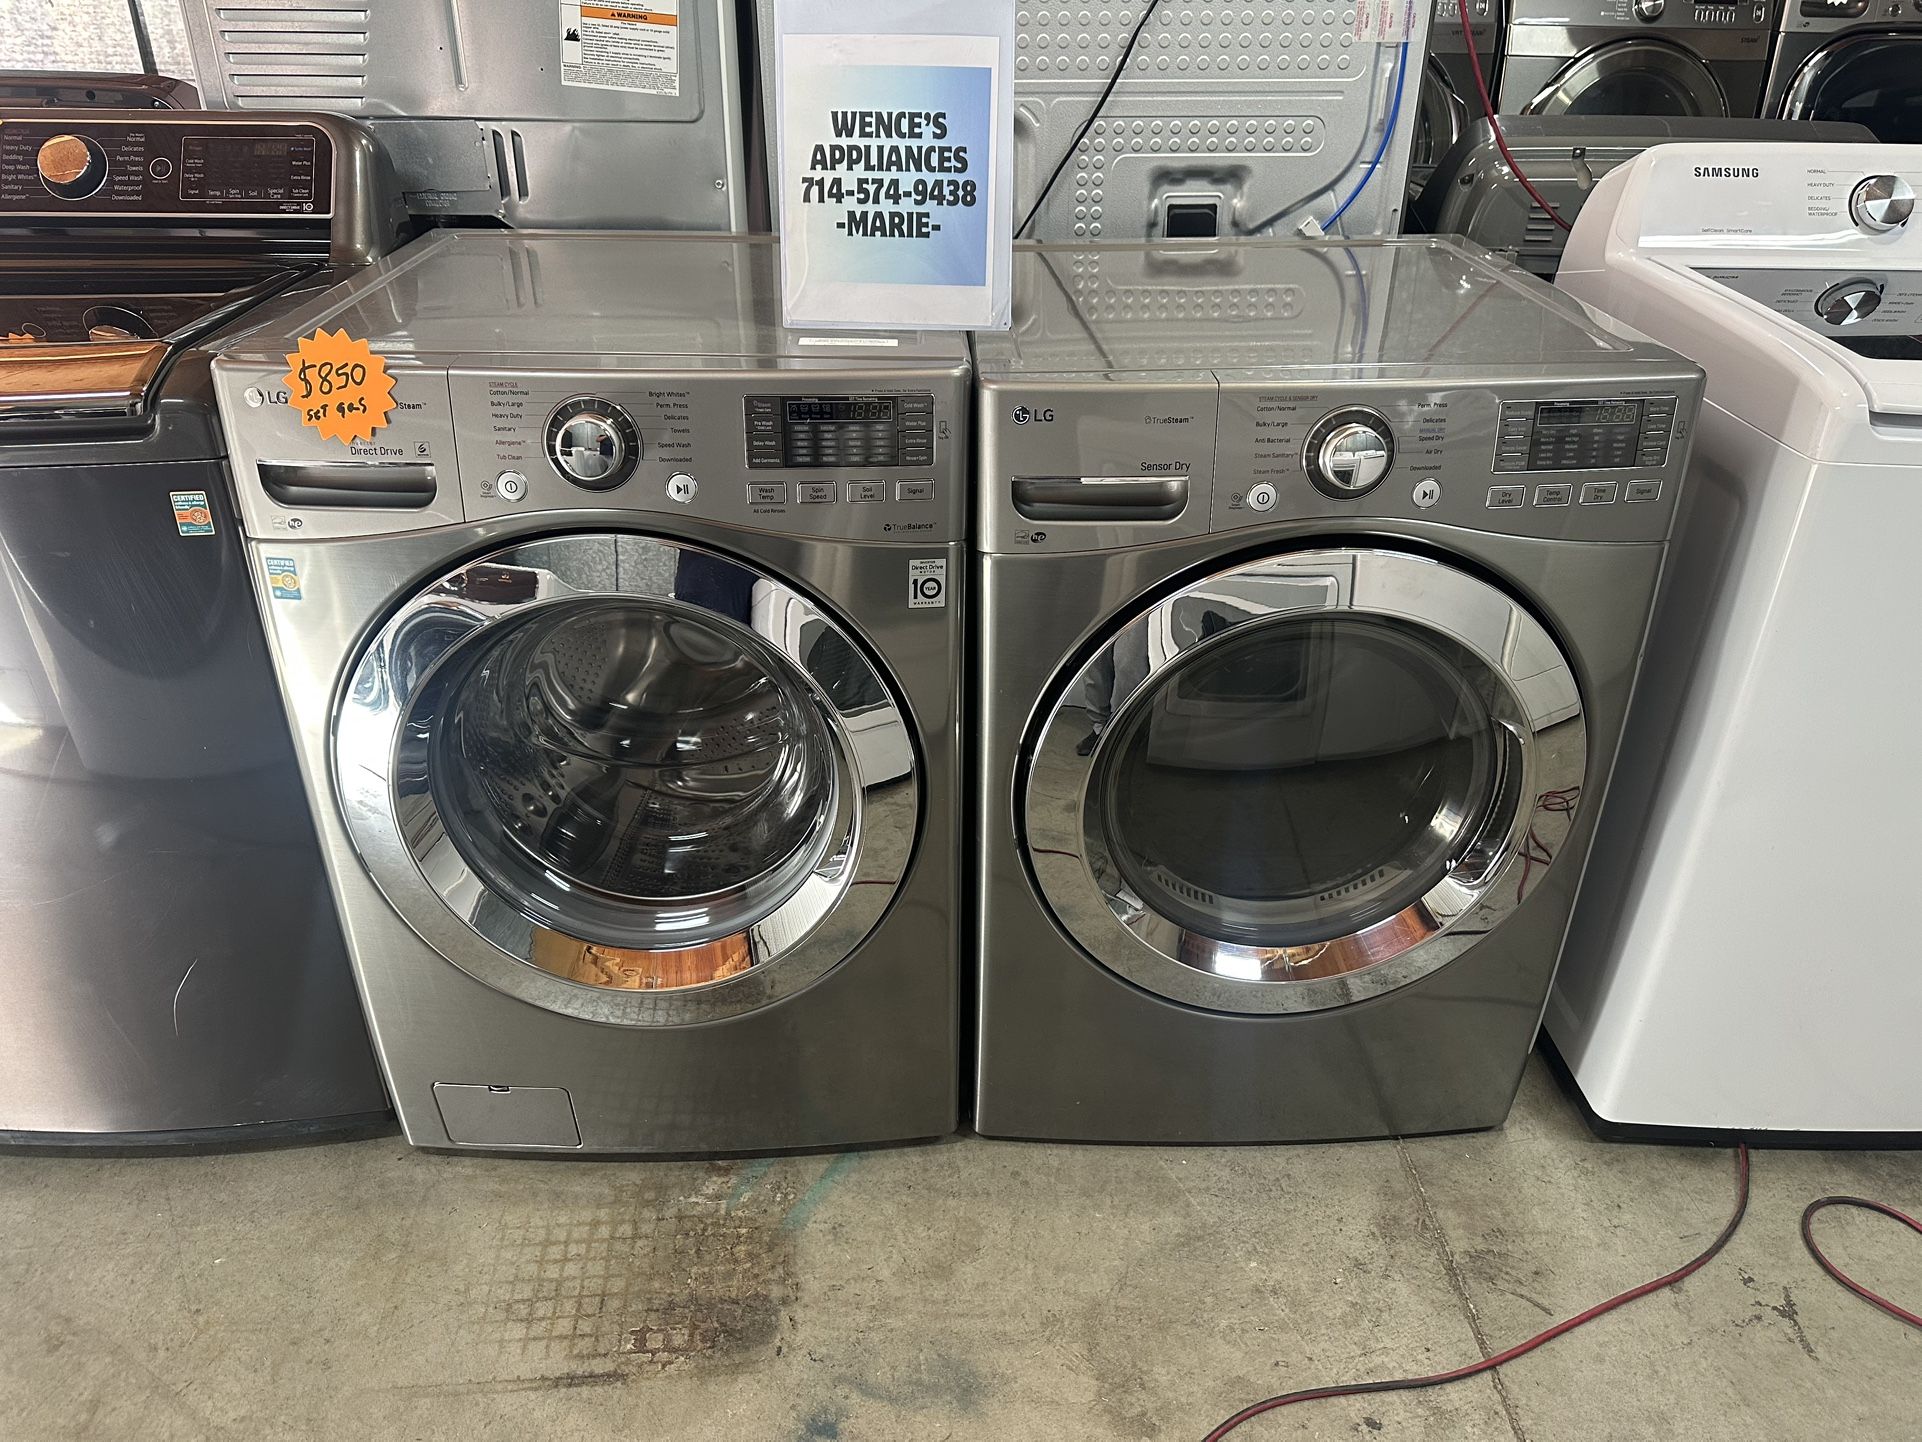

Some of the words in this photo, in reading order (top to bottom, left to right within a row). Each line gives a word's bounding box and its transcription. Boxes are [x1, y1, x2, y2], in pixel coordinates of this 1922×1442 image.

[617, 12, 648, 20] WARNING
[831, 111, 947, 139] WENCE'S
[810, 144, 968, 173] APPLIANCES
[1694, 167, 1759, 178] SAMSUNG
[801, 177, 977, 207] 714-574-9438
[836, 211, 941, 238] -MARIE-
[299, 359, 367, 398] $850
[1034, 409, 1054, 422] LG
[350, 447, 378, 455] Direct
[380, 447, 404, 455] Drive
[1141, 462, 1172, 472] Sensor
[1174, 461, 1191, 473] Dry
[912, 577, 942, 600] 10
